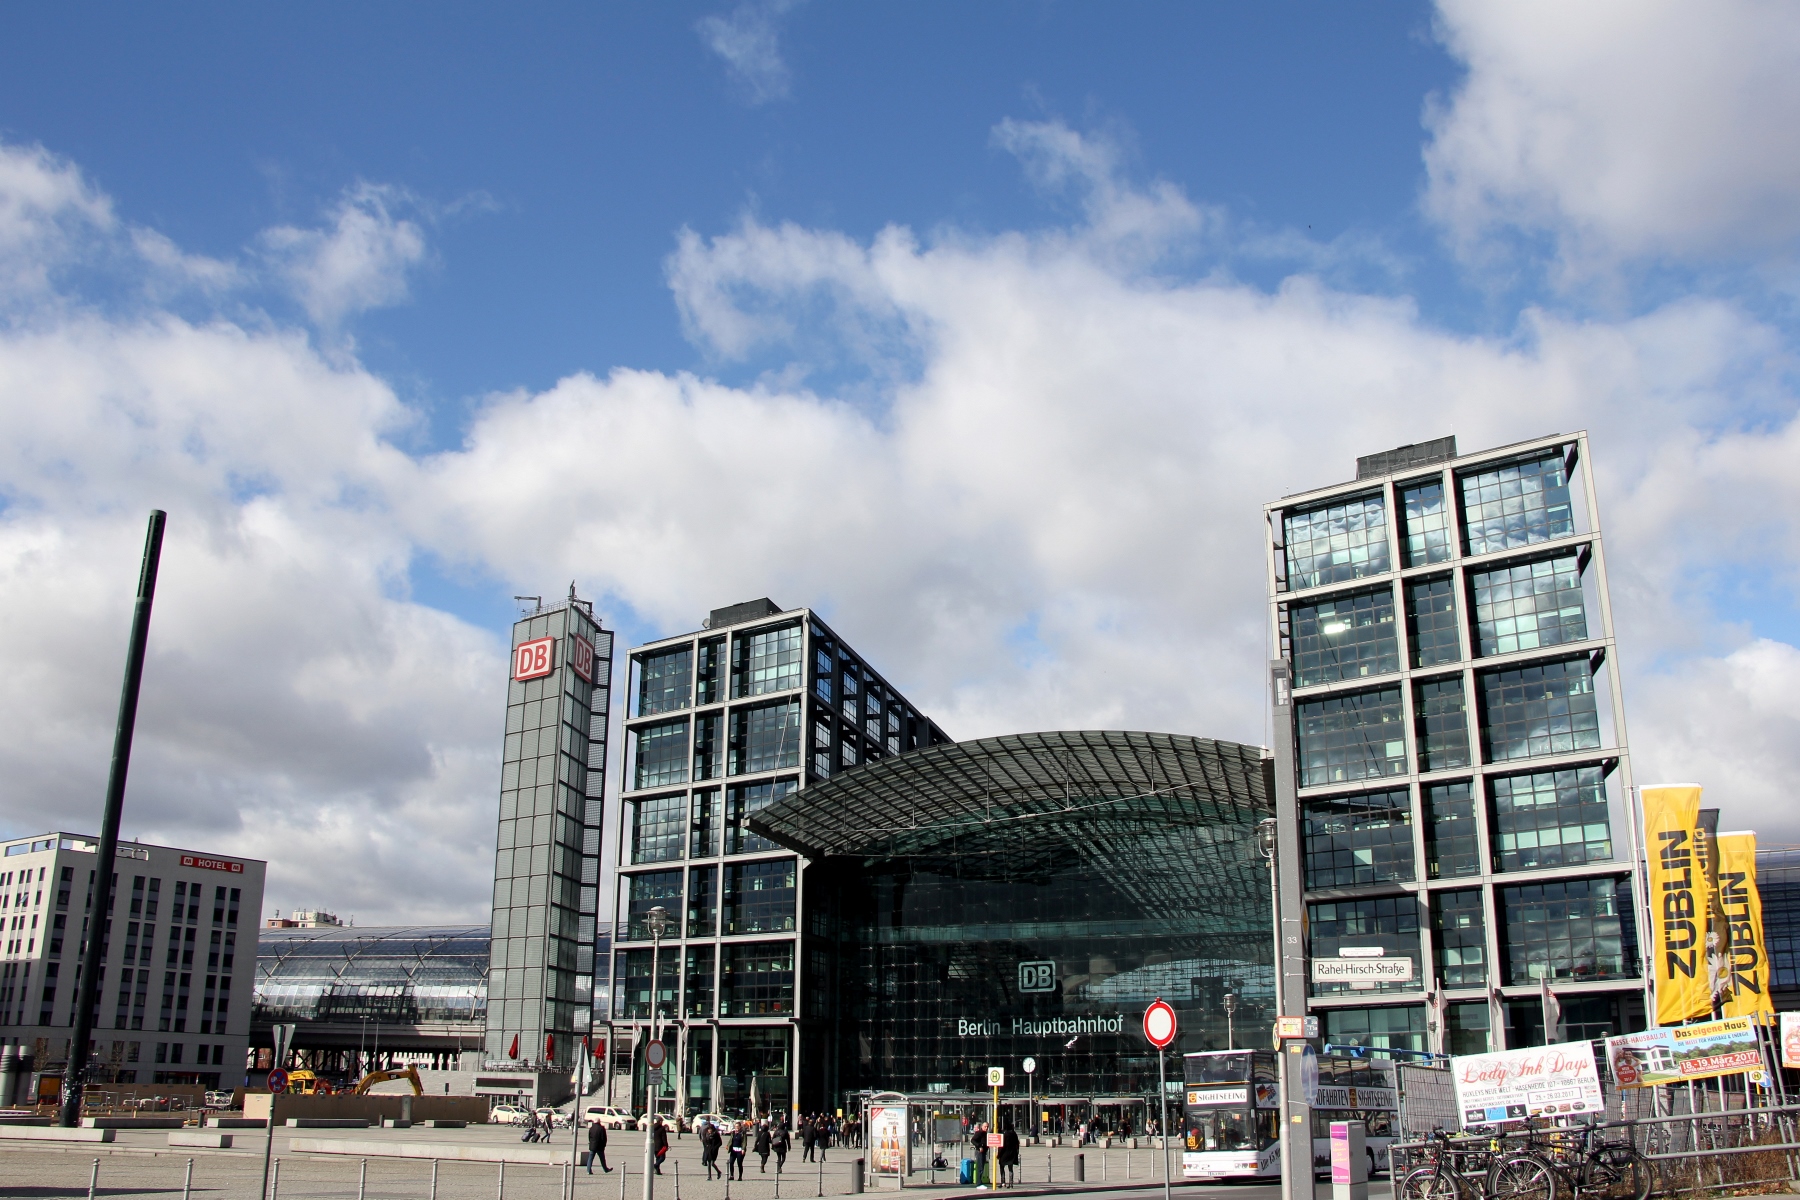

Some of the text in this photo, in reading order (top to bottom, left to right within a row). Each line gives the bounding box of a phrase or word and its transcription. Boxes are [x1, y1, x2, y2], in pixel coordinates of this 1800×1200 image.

[520, 644, 547, 675] DB
[576, 640, 591, 675] DB
[198, 858, 227, 870] HOTEL
[1658, 829, 1697, 980] ZÜBLIN
[1287, 936, 1297, 944] 33
[1719, 871, 1761, 996] ZÜBLIN
[1023, 965, 1051, 988] DB
[1318, 963, 1405, 976] Rahel-Hirsch-Straße
[958, 1014, 1123, 1038] Berlin Hauptbahnhof
[1675, 1021, 1747, 1039] Das eigene Haus
[1611, 1032, 1667, 1046] MESSE-HAUSBAU.DE
[1710, 1056, 1734, 1065] März
[1734, 1051, 1756, 1061] 2017
[1459, 1061, 1508, 1086] Lady
[1508, 1056, 1545, 1077] Ink
[1546, 1051, 1591, 1077] Days
[1198, 1092, 1246, 1101] SIGHTSEEING
[1358, 1090, 1393, 1106] SIGHTSEEING
[1463, 1089, 1484, 1098] HUXLEYS
[1485, 1087, 1497, 1095] NEUE
[1515, 1081, 1546, 1091] HASENHEIDE
